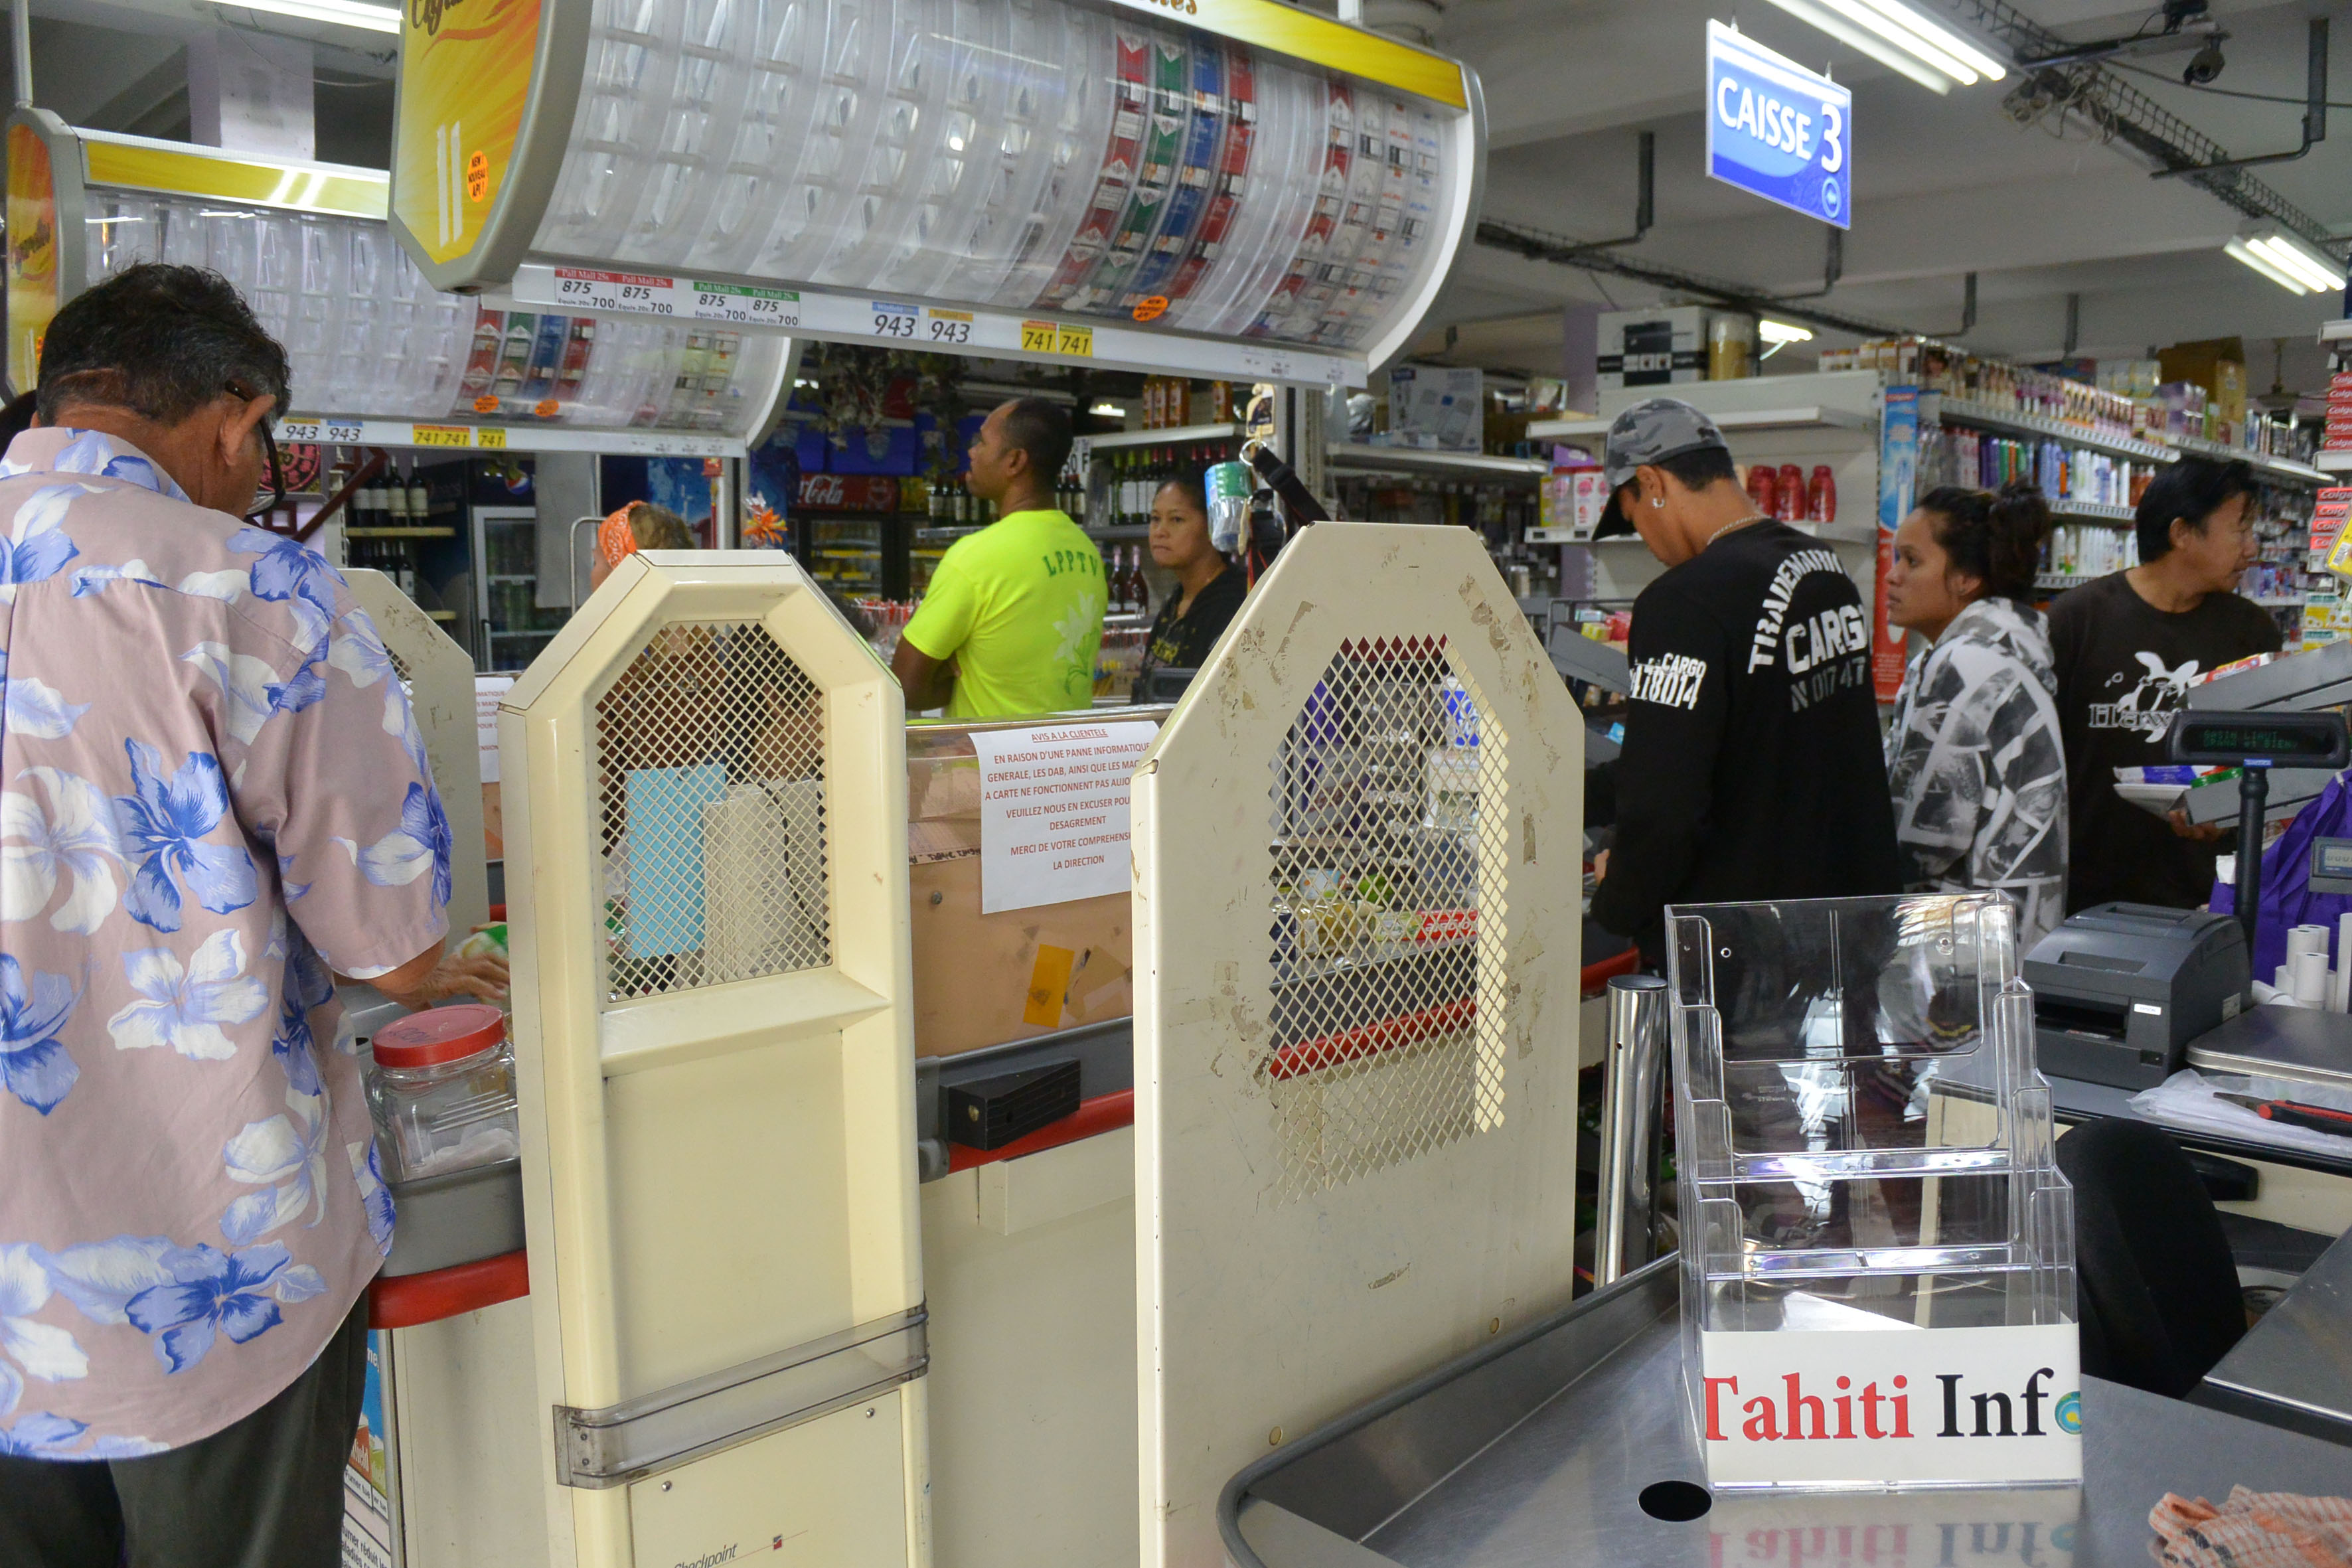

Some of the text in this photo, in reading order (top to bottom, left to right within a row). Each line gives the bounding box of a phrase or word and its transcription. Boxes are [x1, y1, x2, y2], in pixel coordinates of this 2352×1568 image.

[1717, 77, 1843, 173] CAISSE 3
[562, 280, 593, 294] 875
[622, 286, 651, 299] 875
[591, 297, 615, 309] 700
[699, 293, 726, 307] 875
[753, 299, 779, 313] 875
[651, 302, 672, 314] 700
[725, 309, 746, 321] 700
[778, 315, 798, 326] 700
[874, 314, 915, 337] 943
[931, 321, 971, 343] 943
[1024, 331, 1053, 351] 741
[1061, 335, 1089, 354] 741
[285, 425, 319, 439] 943
[329, 428, 361, 442] 943
[416, 431, 439, 444] 741
[444, 433, 467, 445] 741
[480, 434, 503, 447] 741
[1661, 652, 1707, 680] CARGO
[1032, 729, 1108, 742] AVIS A LA CLIENTELE
[994, 755, 1006, 764] EN
[1008, 751, 1038, 763] RAISON
[1040, 750, 1065, 761] D'UNE
[1066, 747, 1093, 758] PANNE
[987, 770, 1032, 783] GENERALE,
[1033, 768, 1047, 778] LES
[1048, 766, 1067, 777] DAB,
[1068, 764, 1089, 775] AINSI
[1091, 763, 1107, 773] QUE
[1108, 761, 1121, 771] LES
[984, 777, 1131, 801] A CARTE NE FONCTIONNENT PAS AUJO
[1006, 806, 1042, 819] VEUILLEZ
[1044, 803, 1066, 815] NOUS
[1067, 802, 1079, 812] EN
[1080, 798, 1113, 811] EXCUSER
[1050, 816, 1107, 830] DESAGREMENT
[1010, 844, 1037, 856] MERCI
[1038, 842, 1050, 852] DE
[1050, 839, 1077, 850] VOTRE
[1053, 854, 1105, 870] LA DIRECTION
[1703, 1372, 1915, 1441] Tahiti
